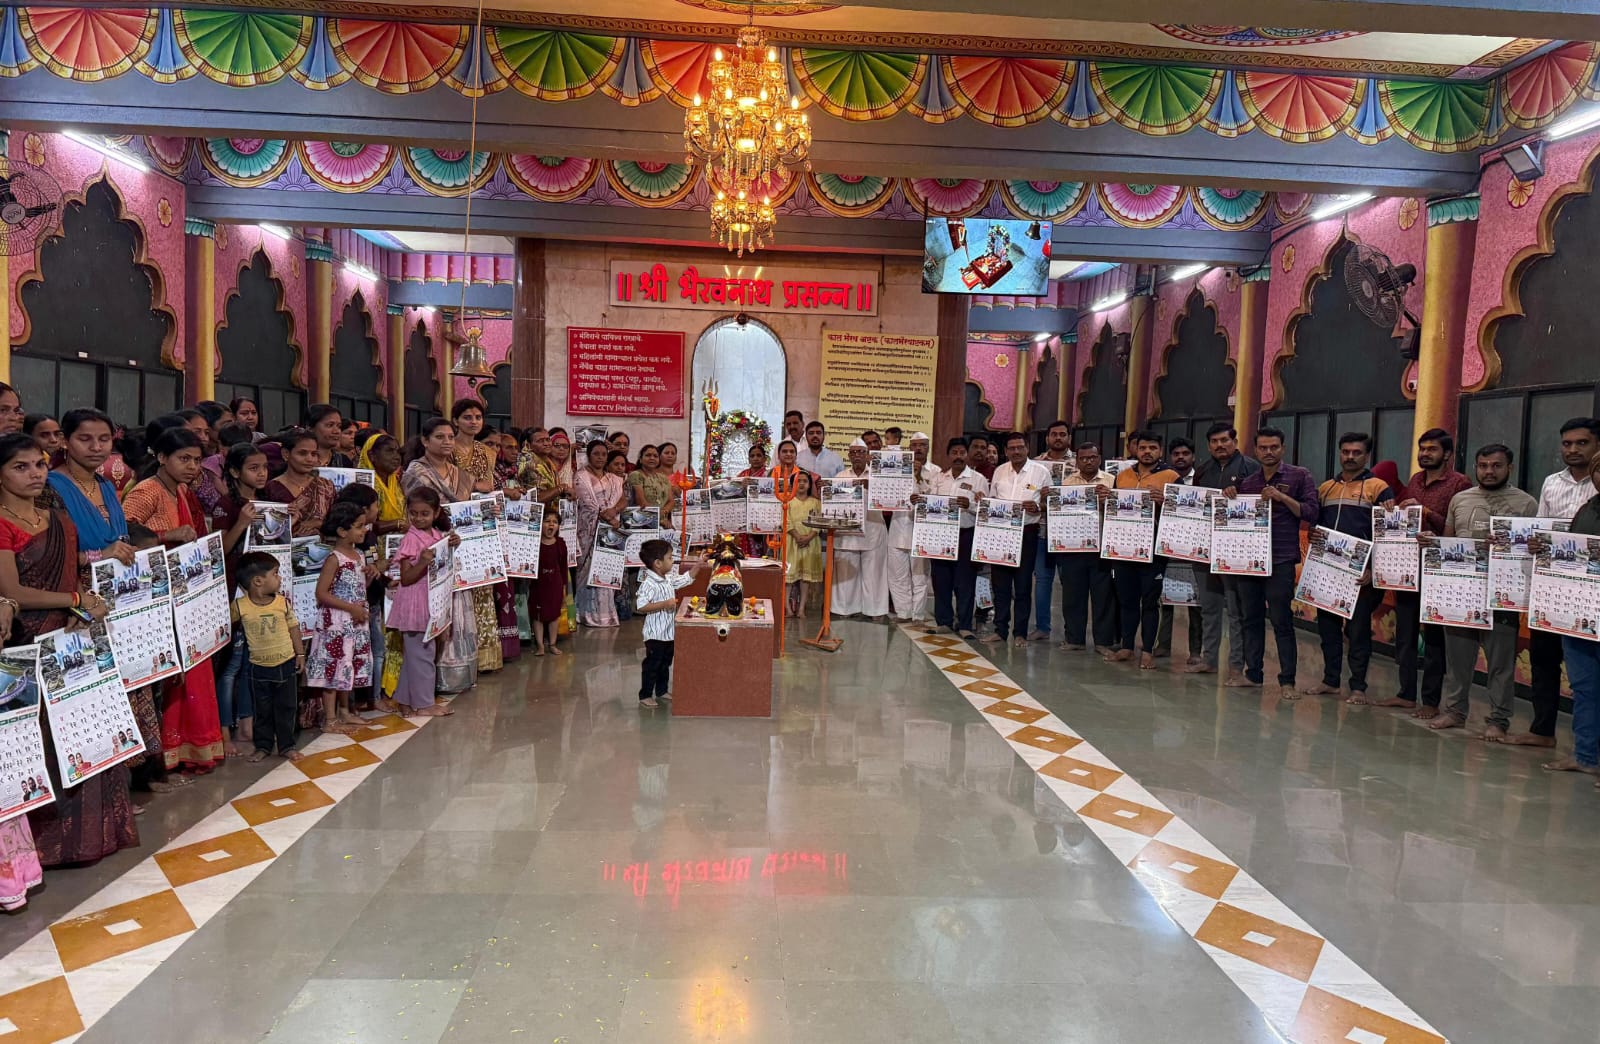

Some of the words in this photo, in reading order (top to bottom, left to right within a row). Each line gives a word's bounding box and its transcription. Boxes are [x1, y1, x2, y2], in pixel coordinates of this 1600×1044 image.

[639, 263, 669, 302] श्री
[679, 265, 773, 306] भैरवनाथ
[782, 281, 851, 309] प्रसन्न
